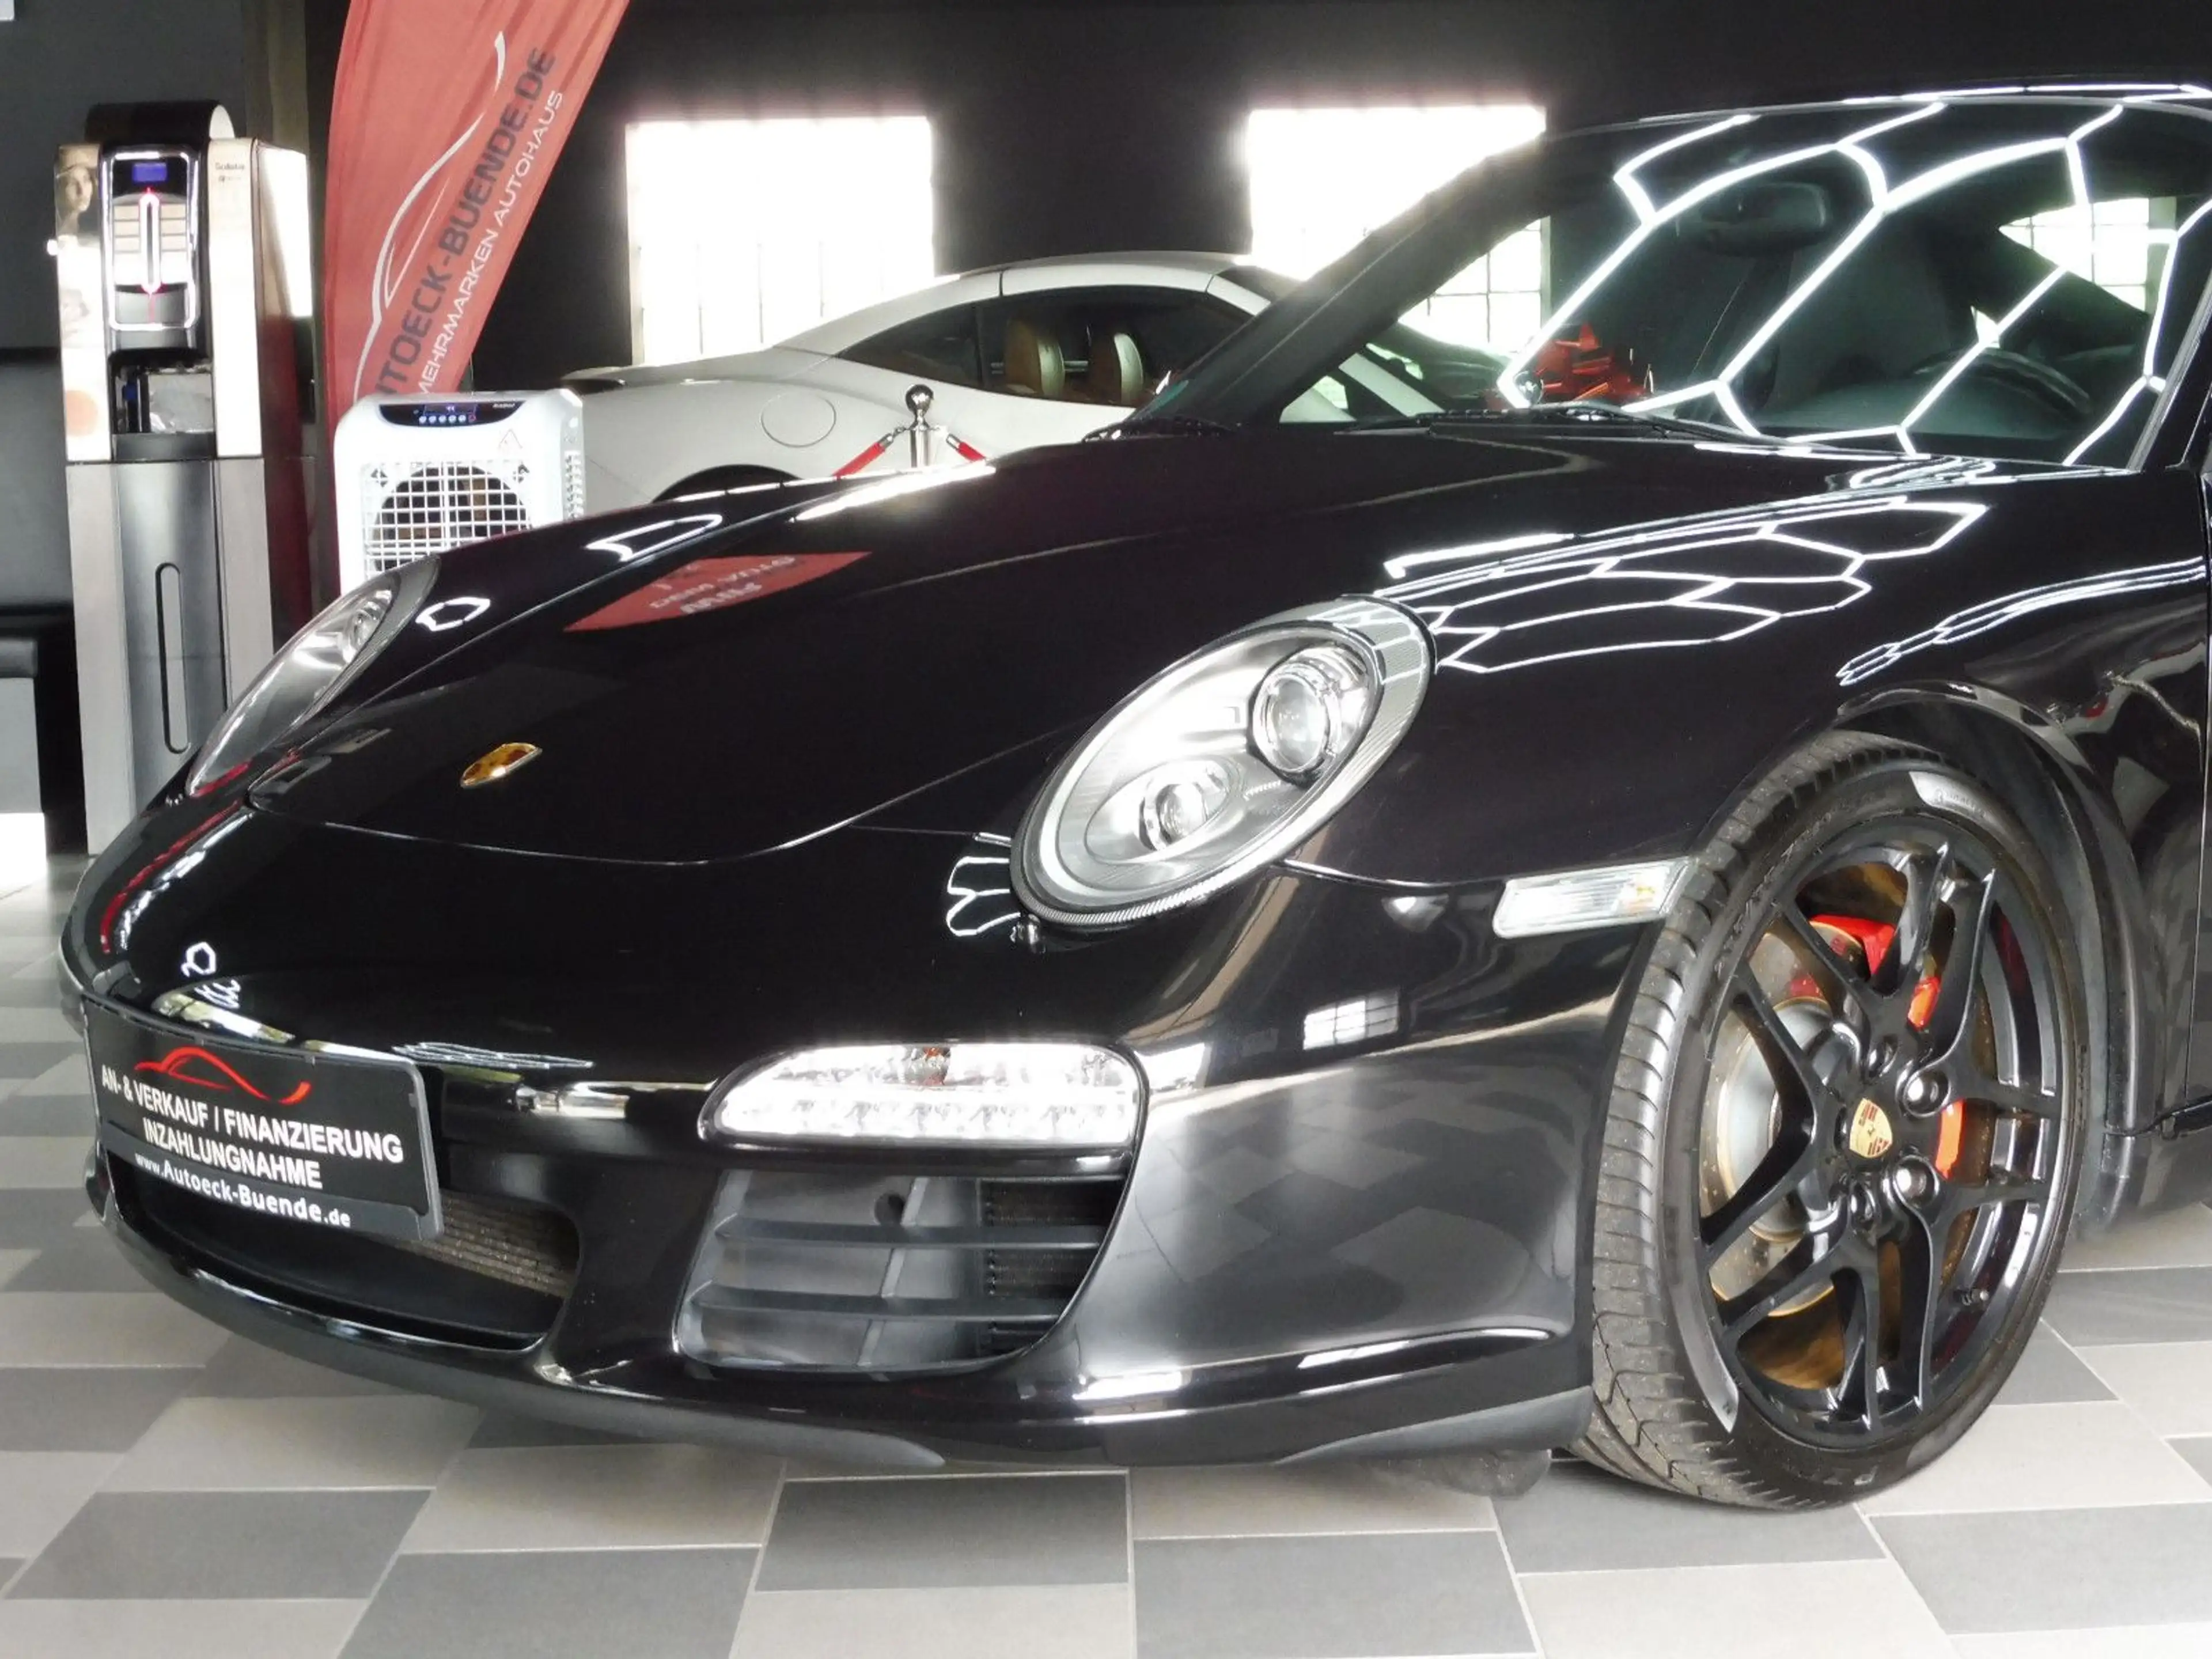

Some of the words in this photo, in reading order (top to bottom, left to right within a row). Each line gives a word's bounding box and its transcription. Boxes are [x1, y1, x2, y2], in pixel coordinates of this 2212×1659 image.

[494, 89, 563, 228] AUTOHAUS
[374, 47, 556, 395] TOECK-BUENDE.DE
[102, 1064, 122, 1094] AN-
[123, 1074, 134, 1103] &
[133, 1080, 209, 1128] VERKAUF
[224, 1107, 404, 1164] FINANZIERUNG
[142, 1116, 323, 1190] INZAHLUNGNAHME
[134, 1152, 351, 1228] www.Autoeck-Buende.de
